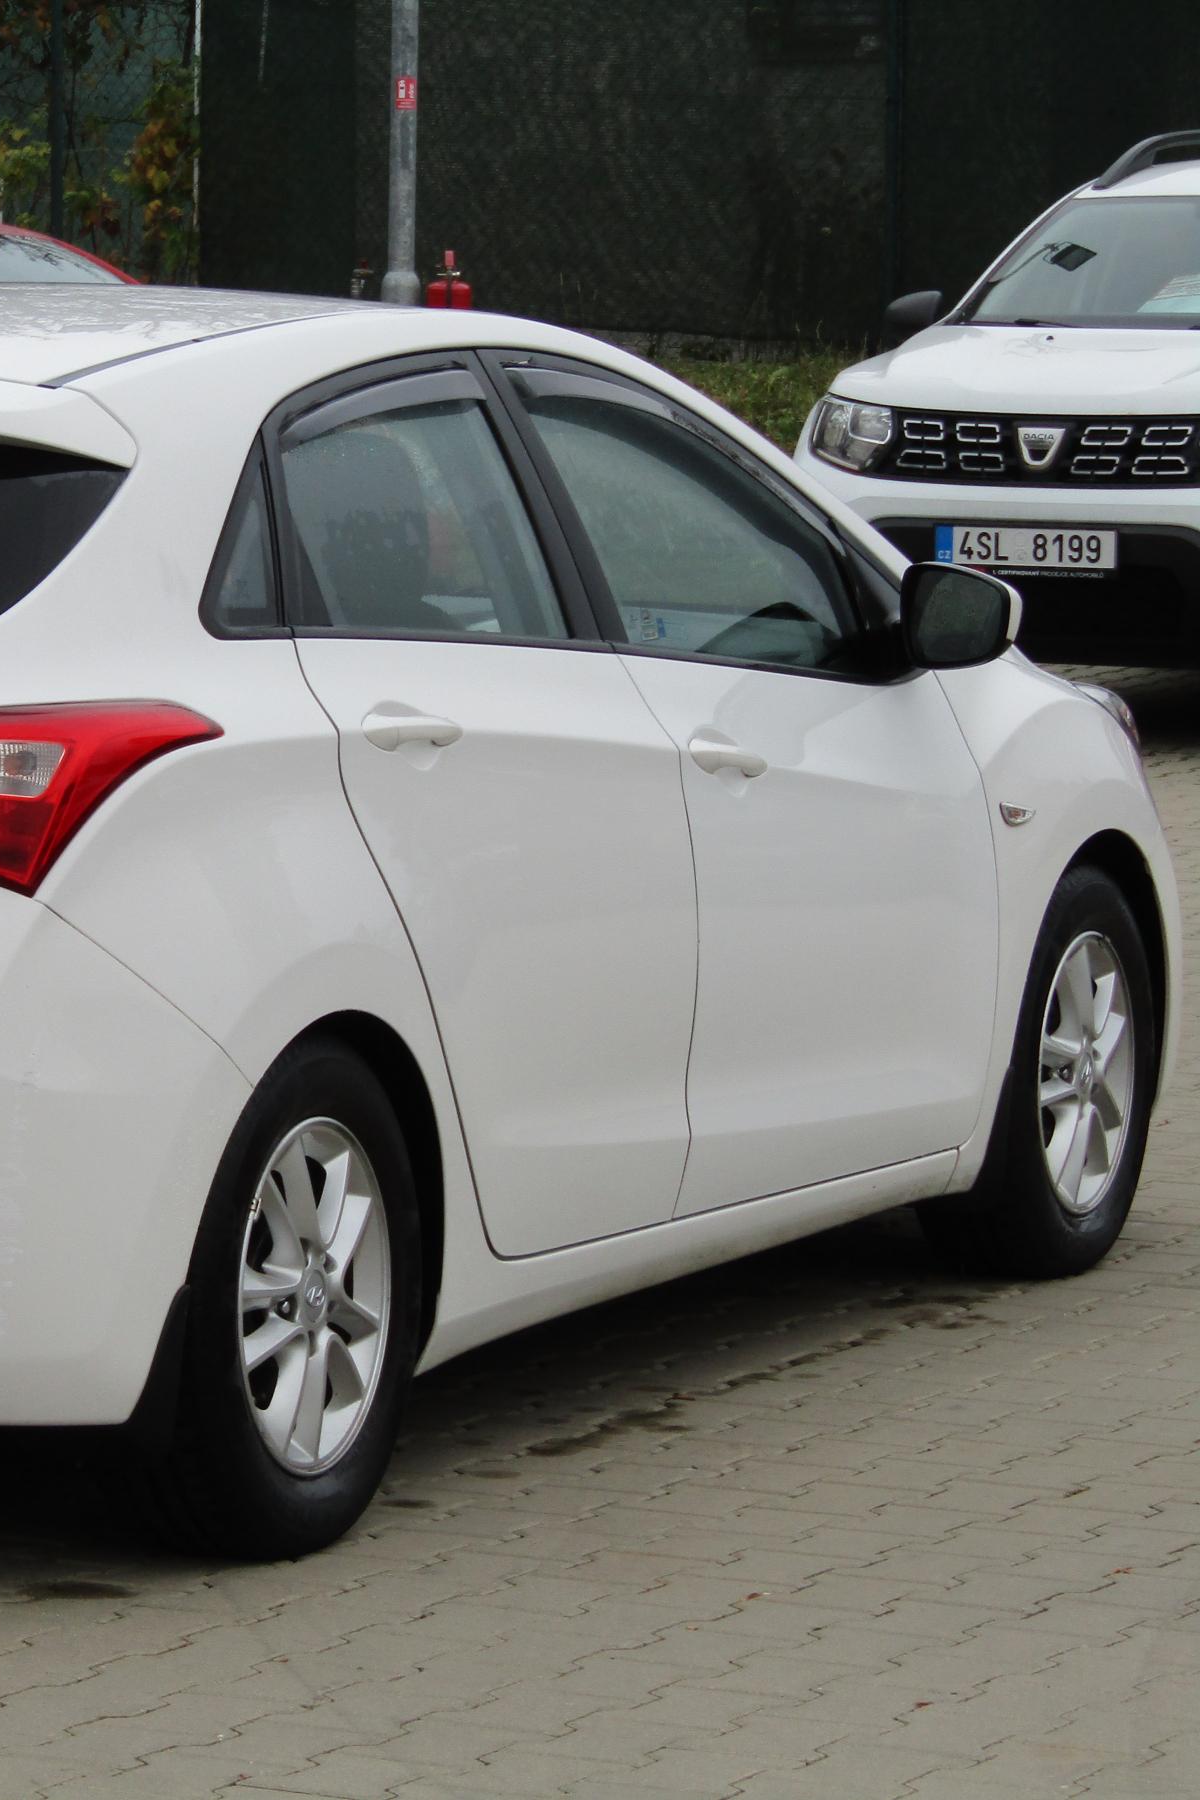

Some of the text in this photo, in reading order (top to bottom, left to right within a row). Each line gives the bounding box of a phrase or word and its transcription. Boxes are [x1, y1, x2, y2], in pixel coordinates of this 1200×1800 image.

[938, 530, 1101, 563] CZ 4SL 8199
